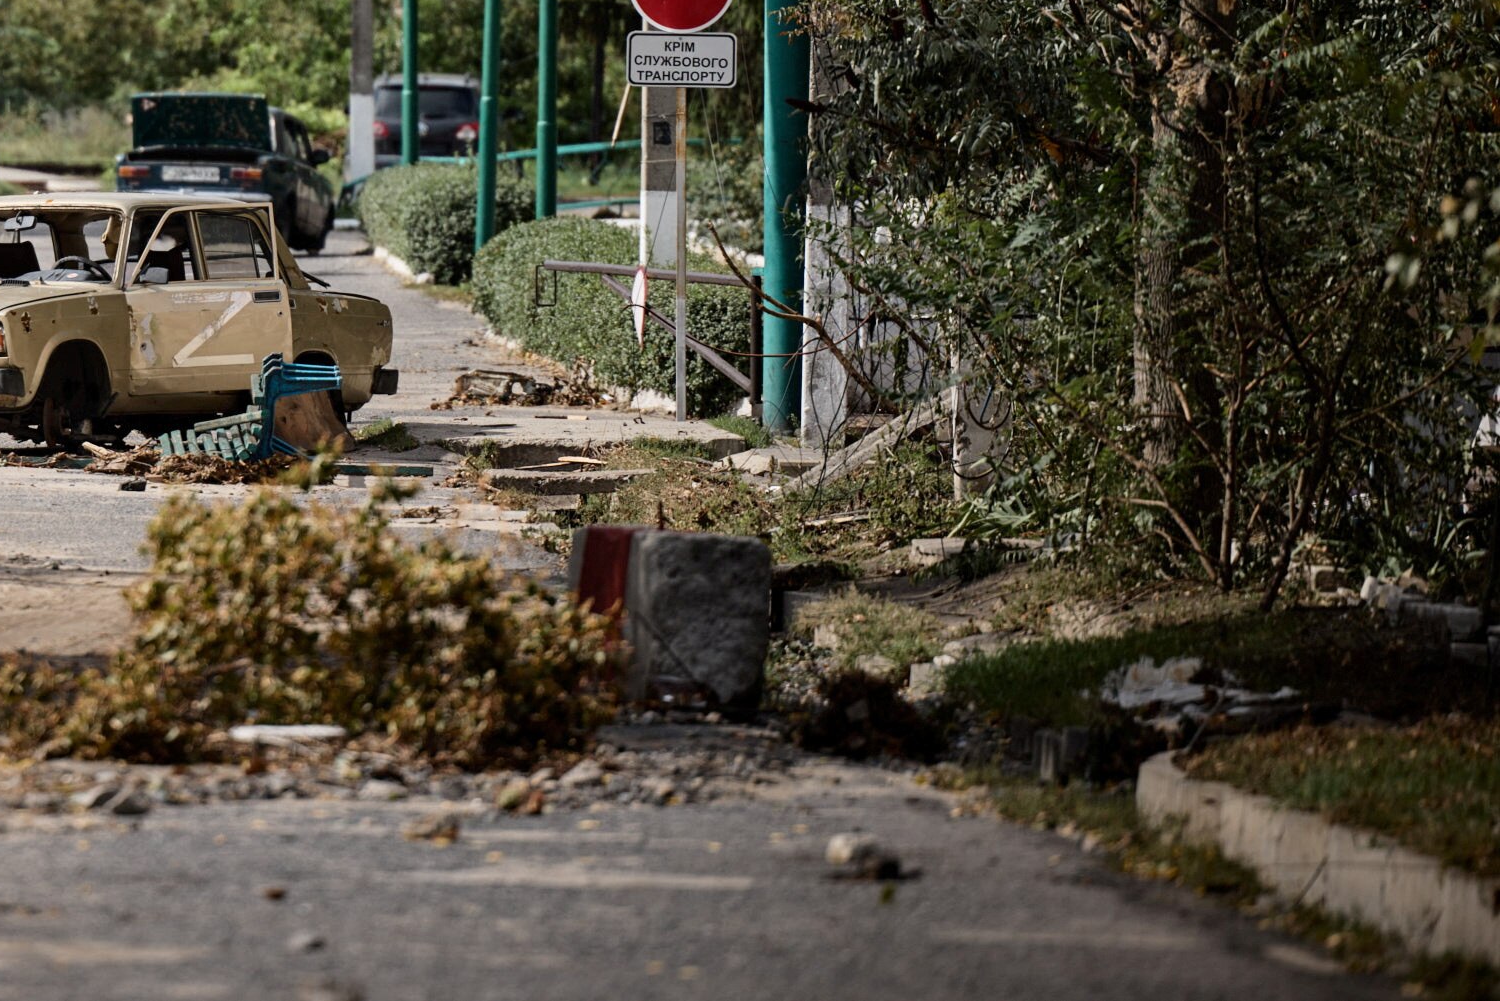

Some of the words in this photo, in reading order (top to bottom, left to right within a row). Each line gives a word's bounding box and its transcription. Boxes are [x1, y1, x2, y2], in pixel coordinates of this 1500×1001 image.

[664, 41, 695, 52] КРІМ
[634, 54, 729, 69] СЛУЖБОВОГО
[636, 70, 725, 82] ТРАНСПОРТУ
